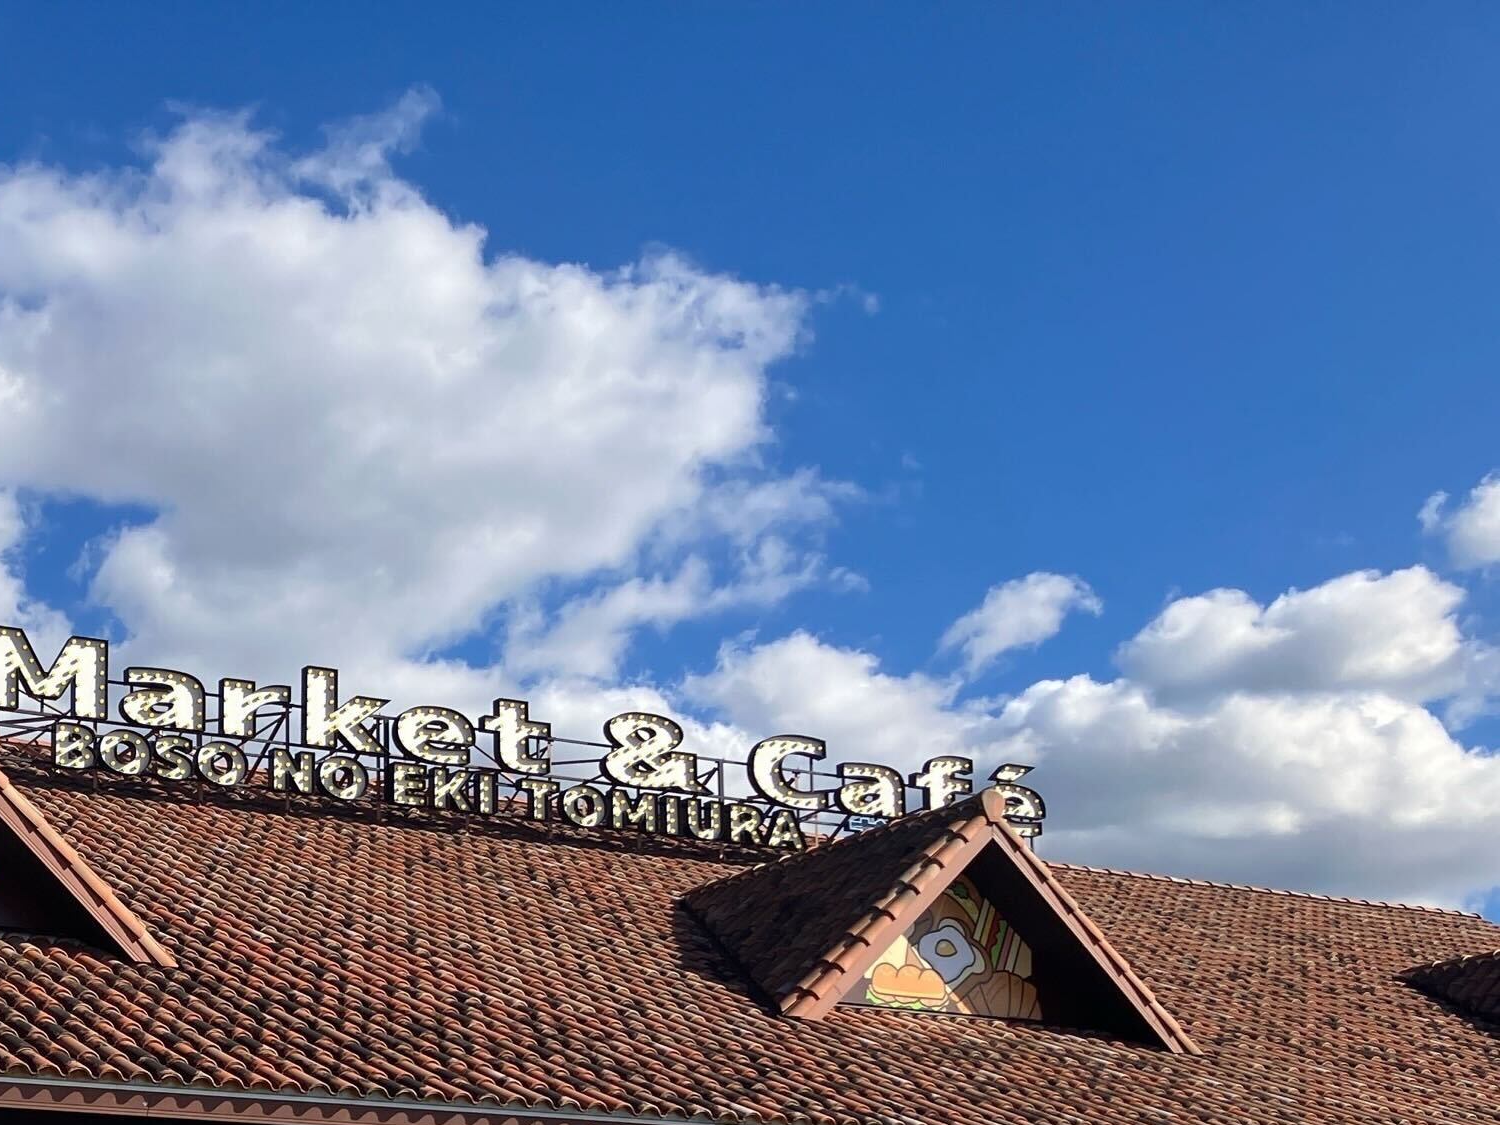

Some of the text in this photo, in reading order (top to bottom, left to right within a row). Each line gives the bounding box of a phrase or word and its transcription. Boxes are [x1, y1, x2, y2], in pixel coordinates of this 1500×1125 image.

[55, 722, 806, 851] BOSO NO EKI TOMIURA
[601, 712, 711, 796] &
[748, 734, 1046, 837] Café
